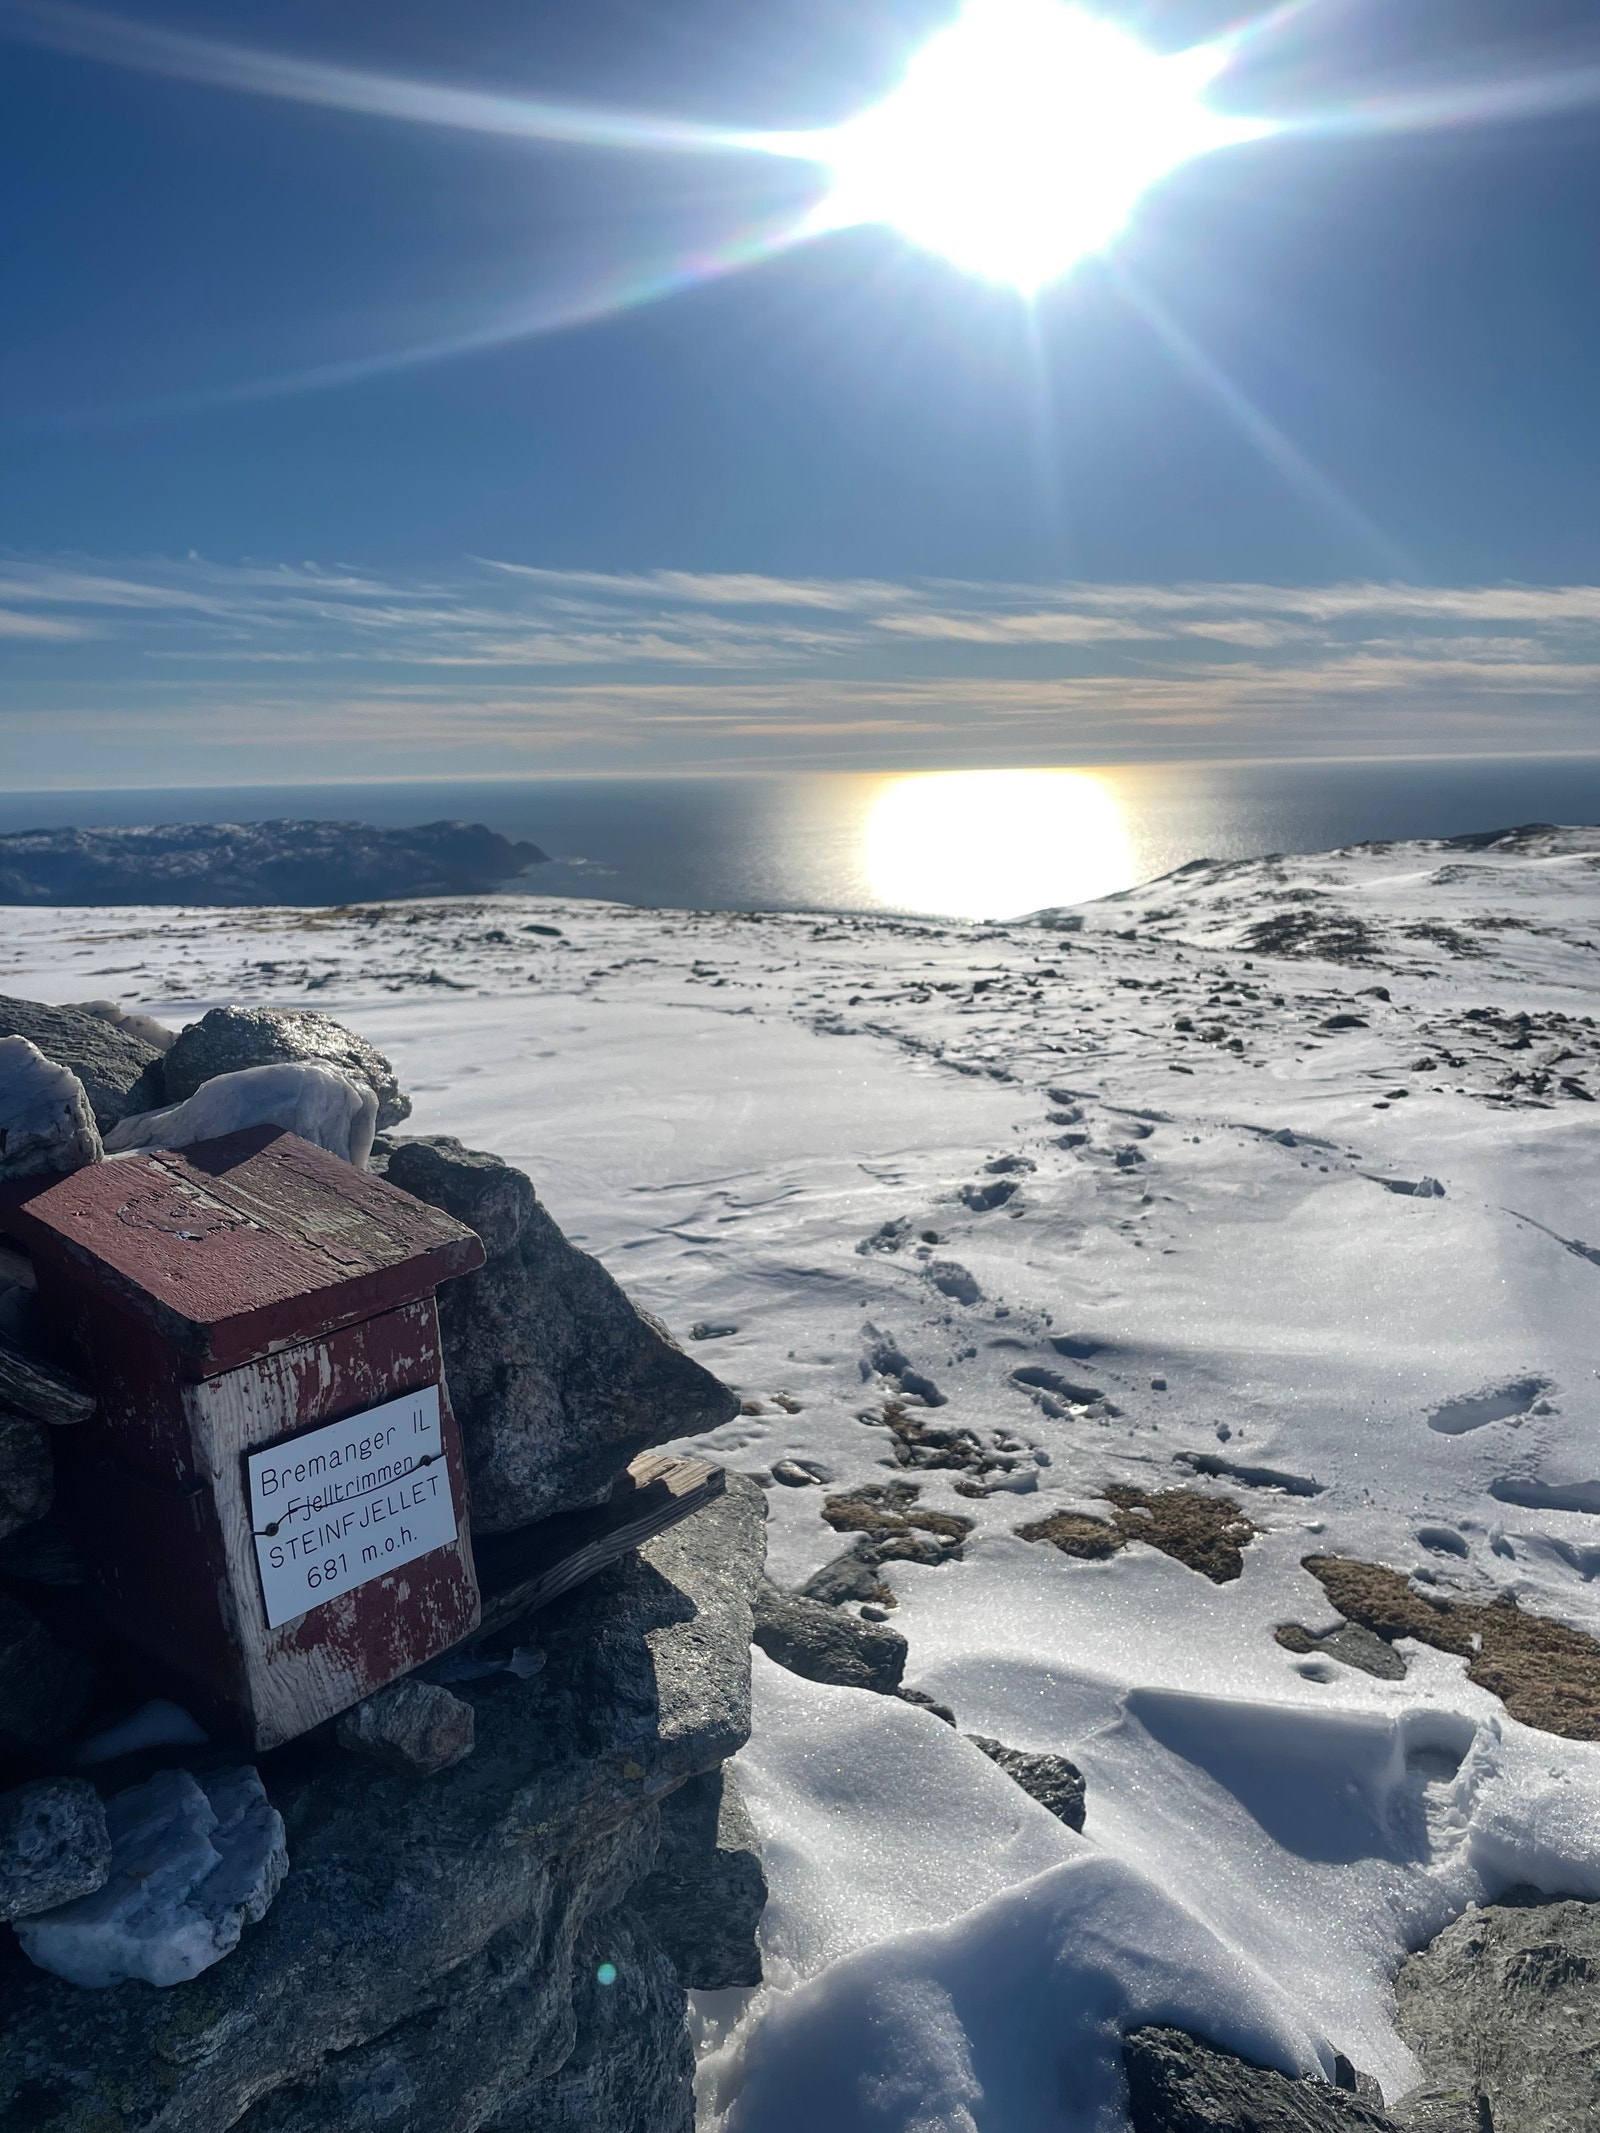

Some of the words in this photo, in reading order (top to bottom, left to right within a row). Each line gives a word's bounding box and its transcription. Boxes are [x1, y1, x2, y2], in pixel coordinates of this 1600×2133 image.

[261, 1426, 396, 1497] Bremanger
[413, 1409, 431, 1434] IL
[287, 1456, 413, 1524] Fjelltrimmen
[269, 1475, 439, 1569] STEINFJELLET
[307, 1553, 348, 1589] 681
[361, 1526, 418, 1564] m.o.h.
